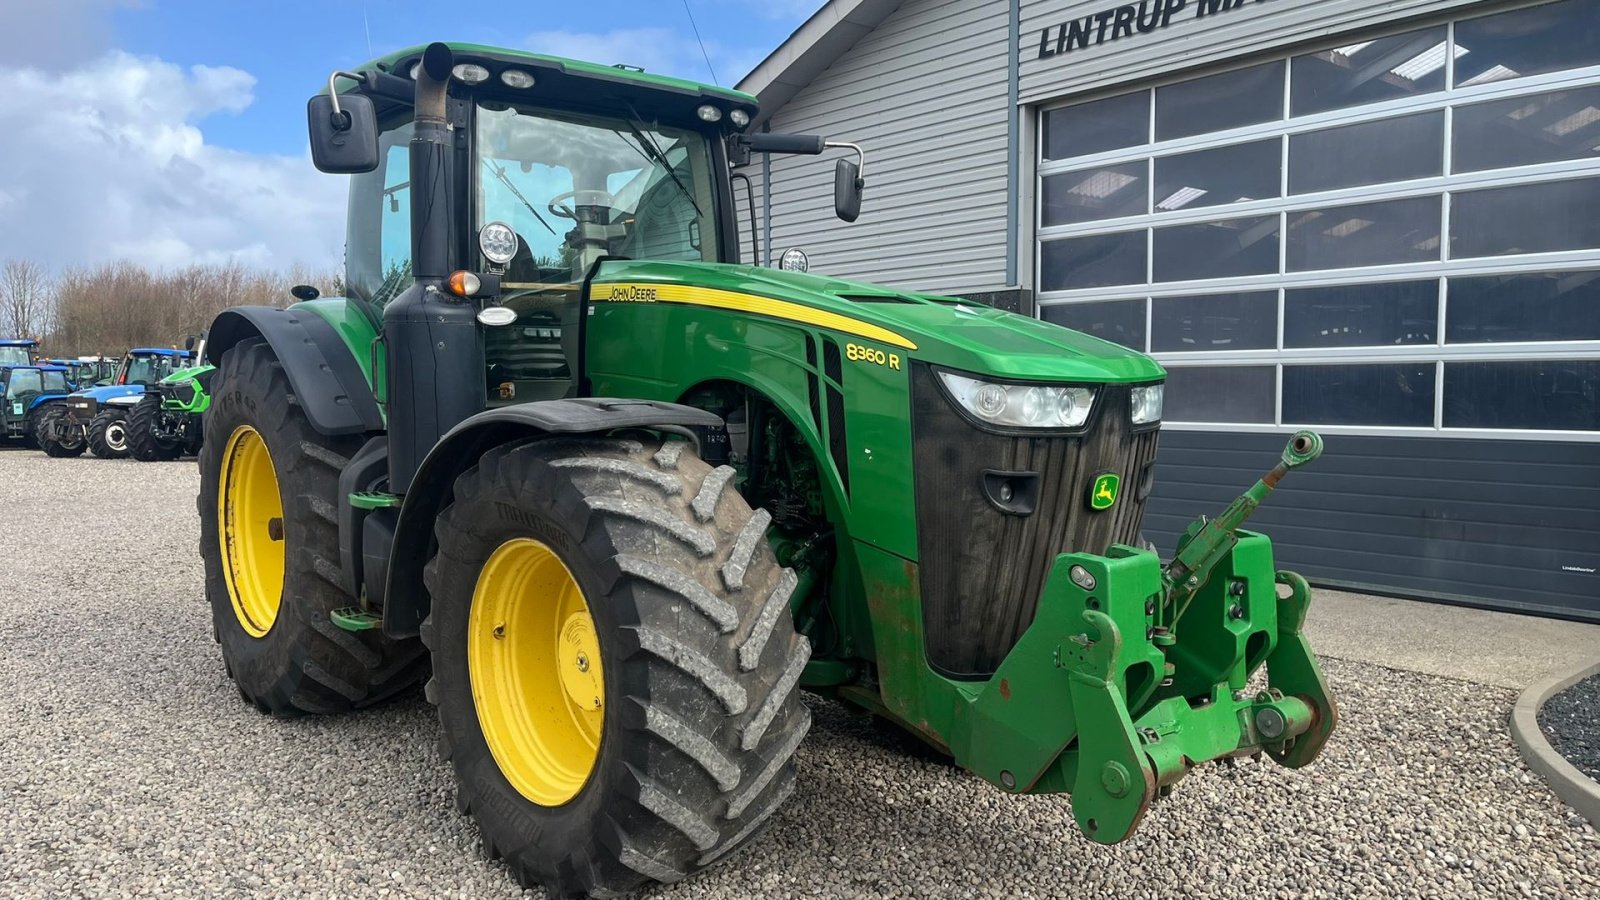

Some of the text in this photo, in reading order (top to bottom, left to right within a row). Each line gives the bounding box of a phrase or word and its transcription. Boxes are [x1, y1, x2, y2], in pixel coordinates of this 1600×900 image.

[1038, 0, 1186, 59] LINTRUP
[608, 285, 656, 300] JOHN DEERE
[846, 342, 900, 371] 8360 R
